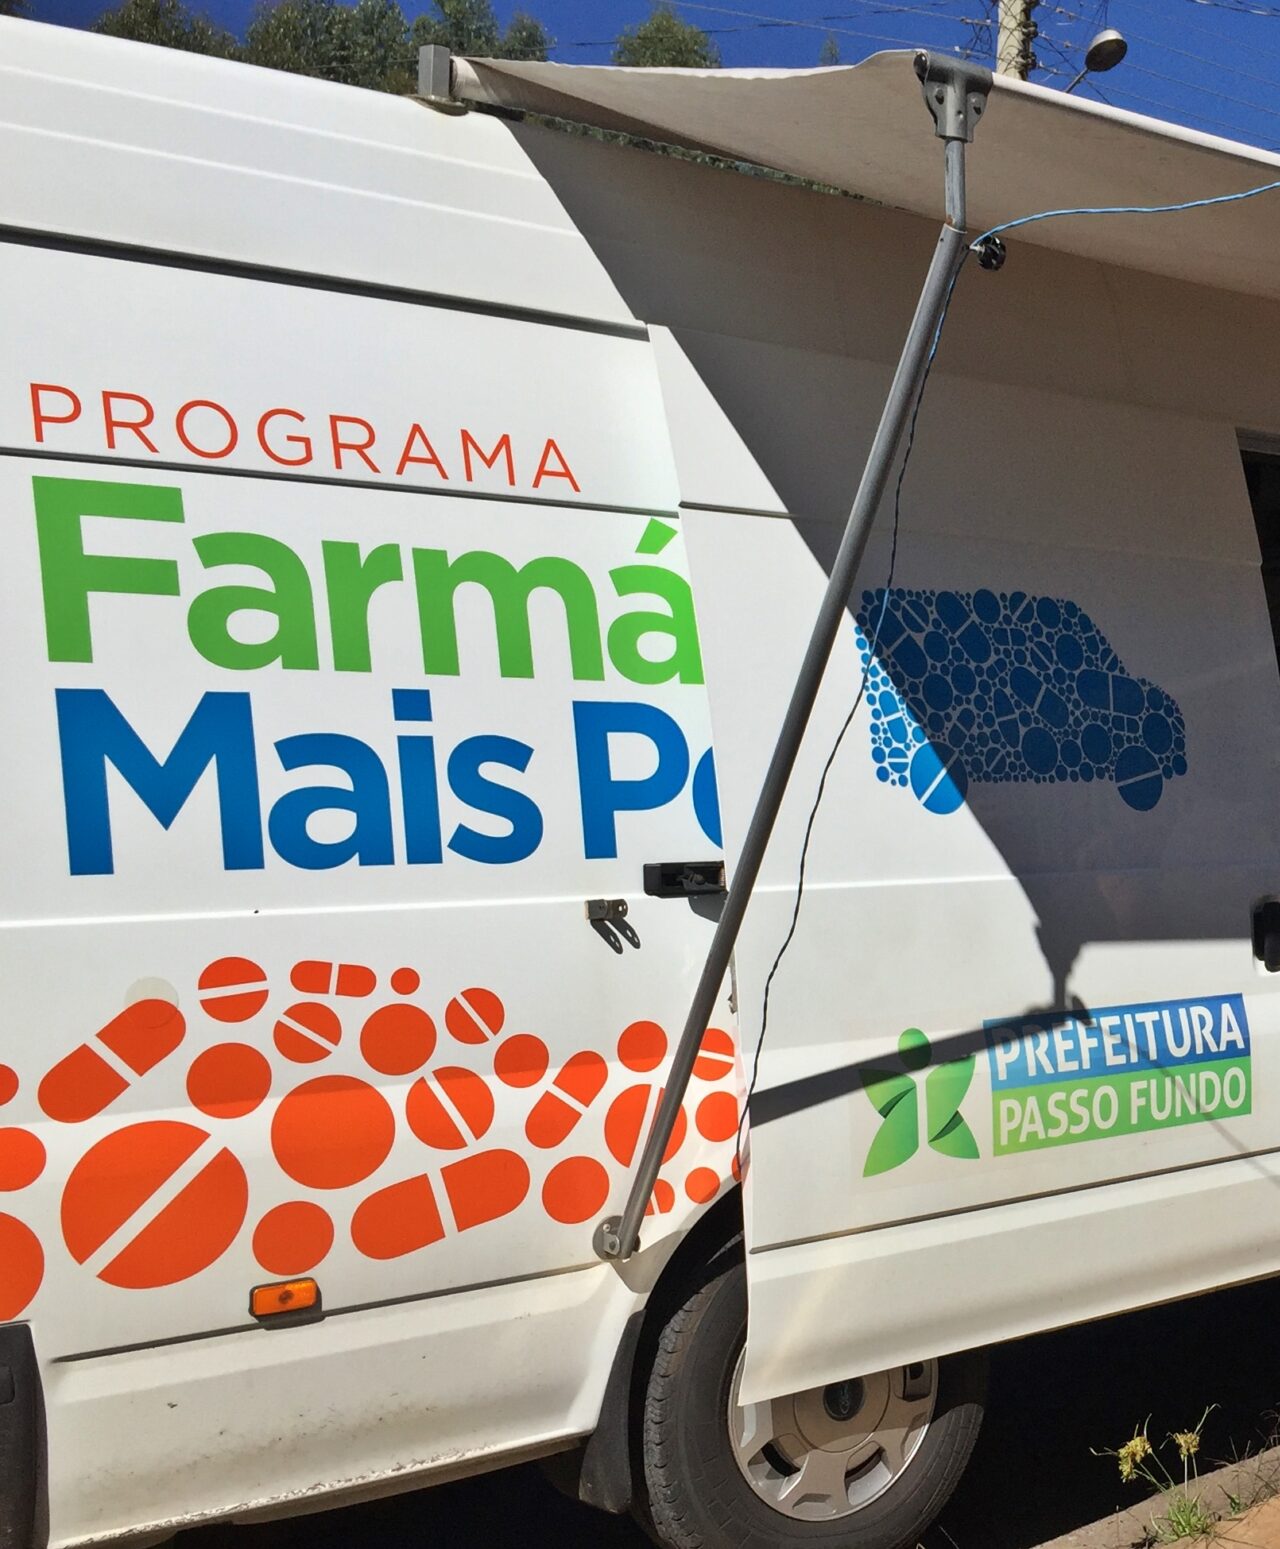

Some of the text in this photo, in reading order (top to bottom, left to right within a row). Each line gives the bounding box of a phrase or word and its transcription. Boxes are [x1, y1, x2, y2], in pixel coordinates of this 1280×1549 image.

[29, 382, 582, 493] PROGRAMA
[31, 475, 706, 686] Farmá
[54, 688, 544, 876] Mais
[993, 1002, 1246, 1081] PREFEITURA
[999, 1066, 1246, 1146] PASSO FUNDO
